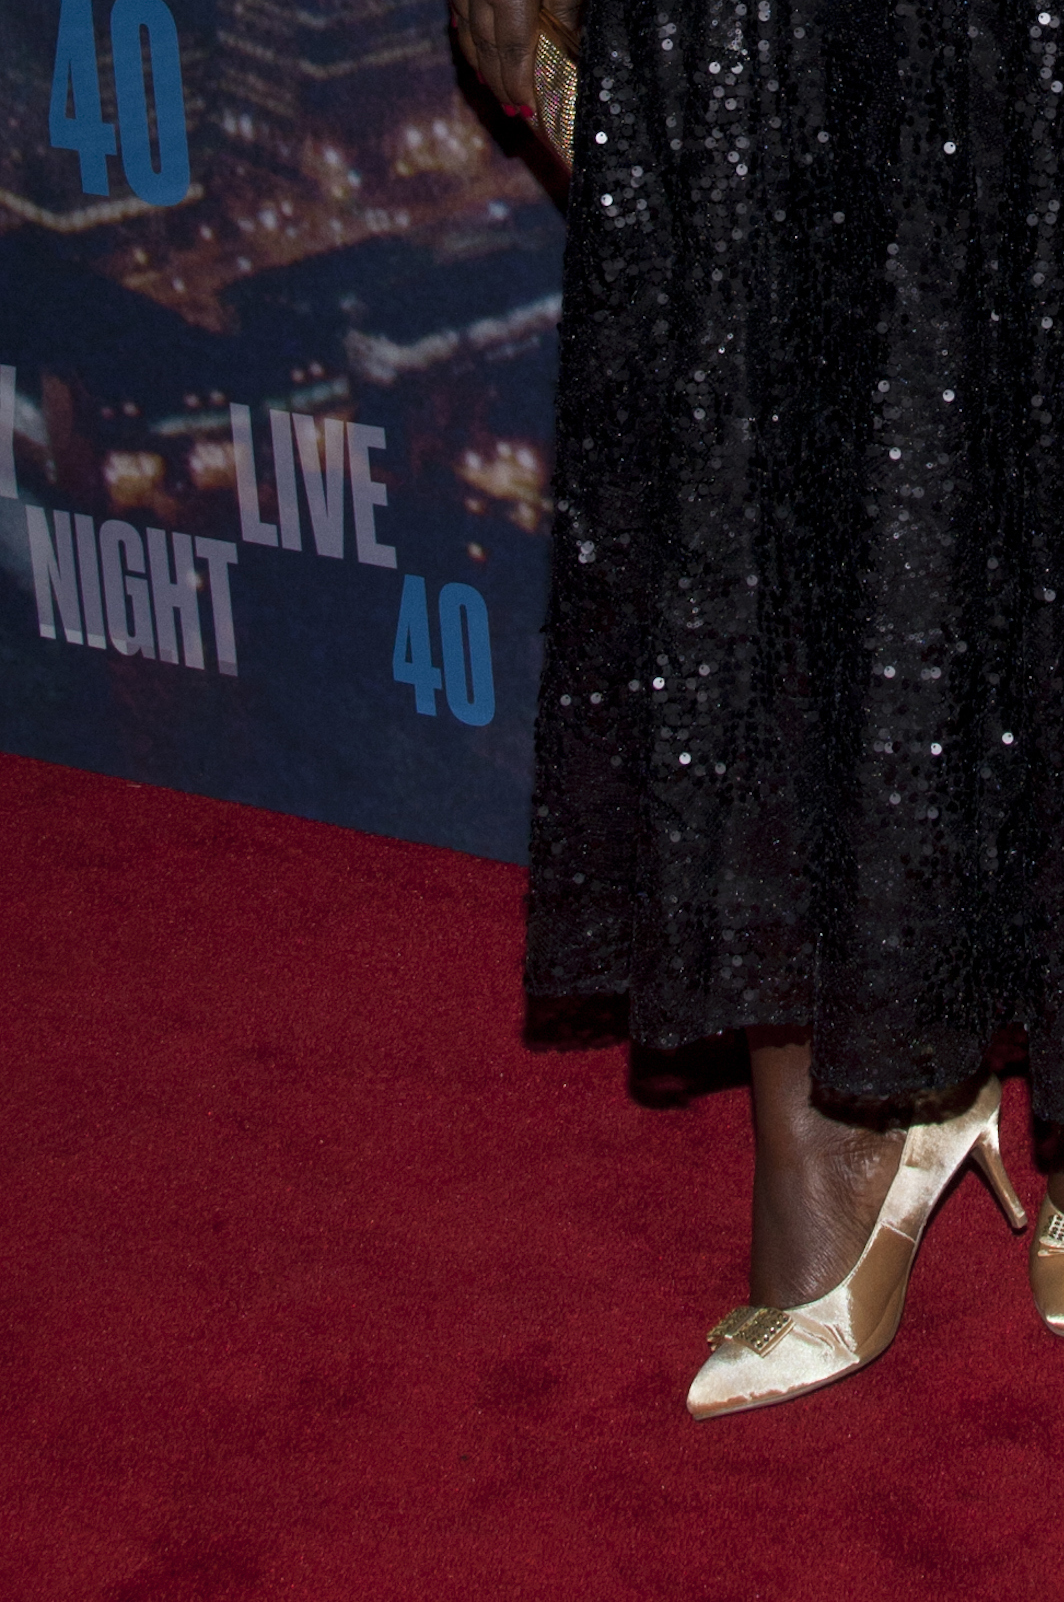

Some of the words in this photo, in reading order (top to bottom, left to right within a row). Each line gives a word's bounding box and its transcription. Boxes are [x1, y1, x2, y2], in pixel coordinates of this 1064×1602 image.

[230, 402, 397, 569] LIVE
[25, 504, 238, 677] NIGHT
[393, 574, 495, 726] 40
